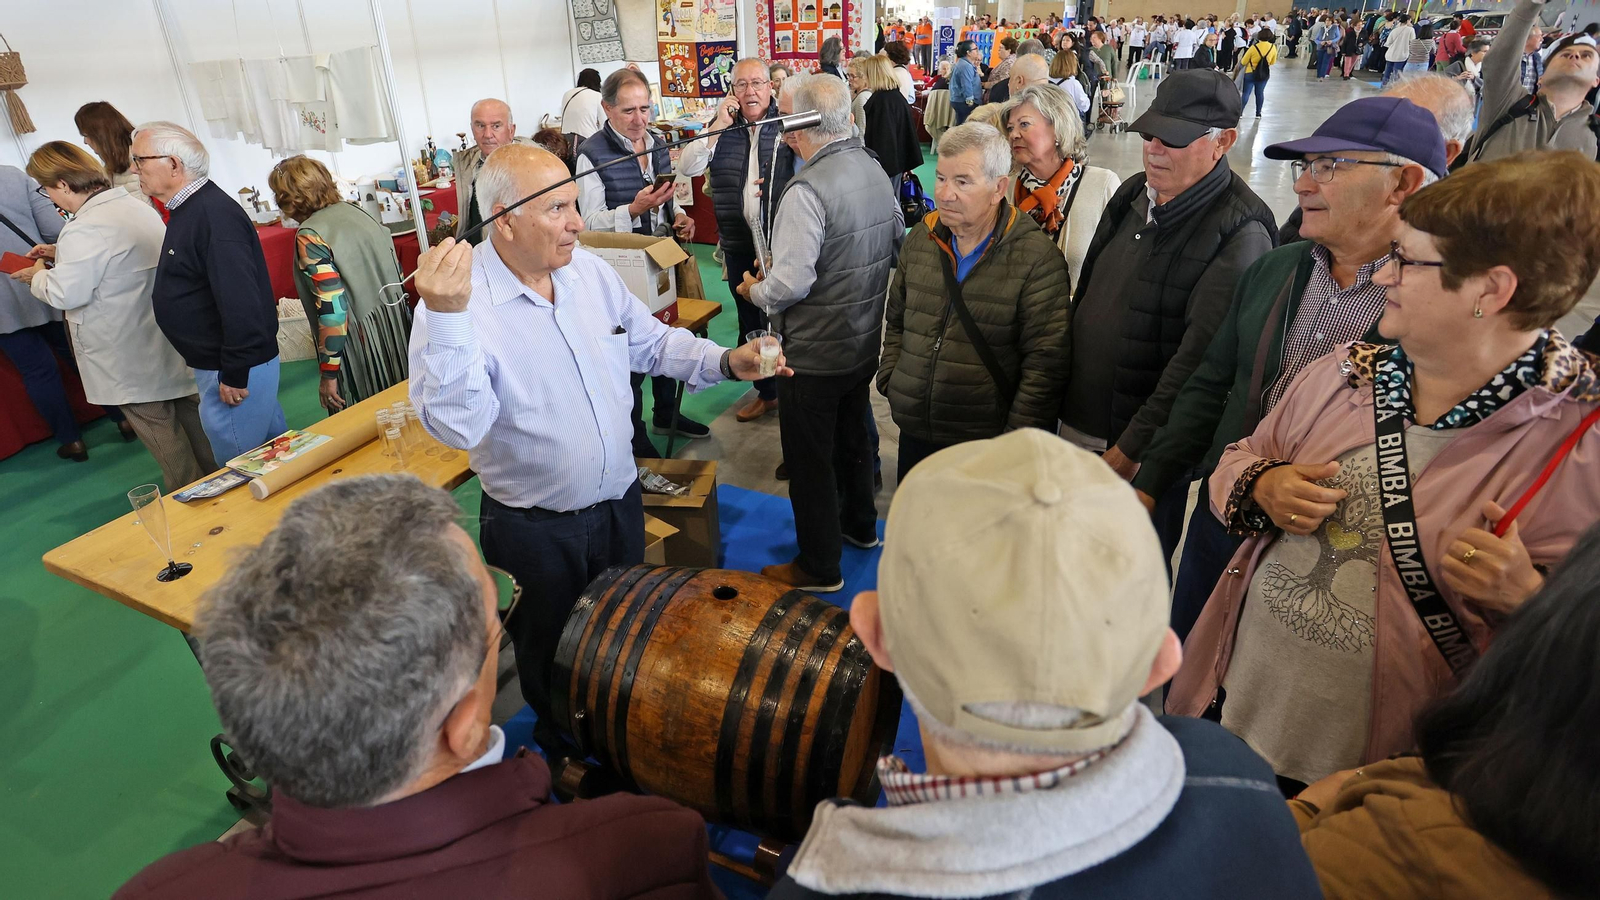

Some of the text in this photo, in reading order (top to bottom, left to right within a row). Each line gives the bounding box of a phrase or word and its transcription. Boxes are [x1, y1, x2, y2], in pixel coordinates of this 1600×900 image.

[666, 43, 690, 58] JESSIE
[1378, 432, 1410, 508] BIMBA
[1387, 522, 1436, 602] BIMBA
